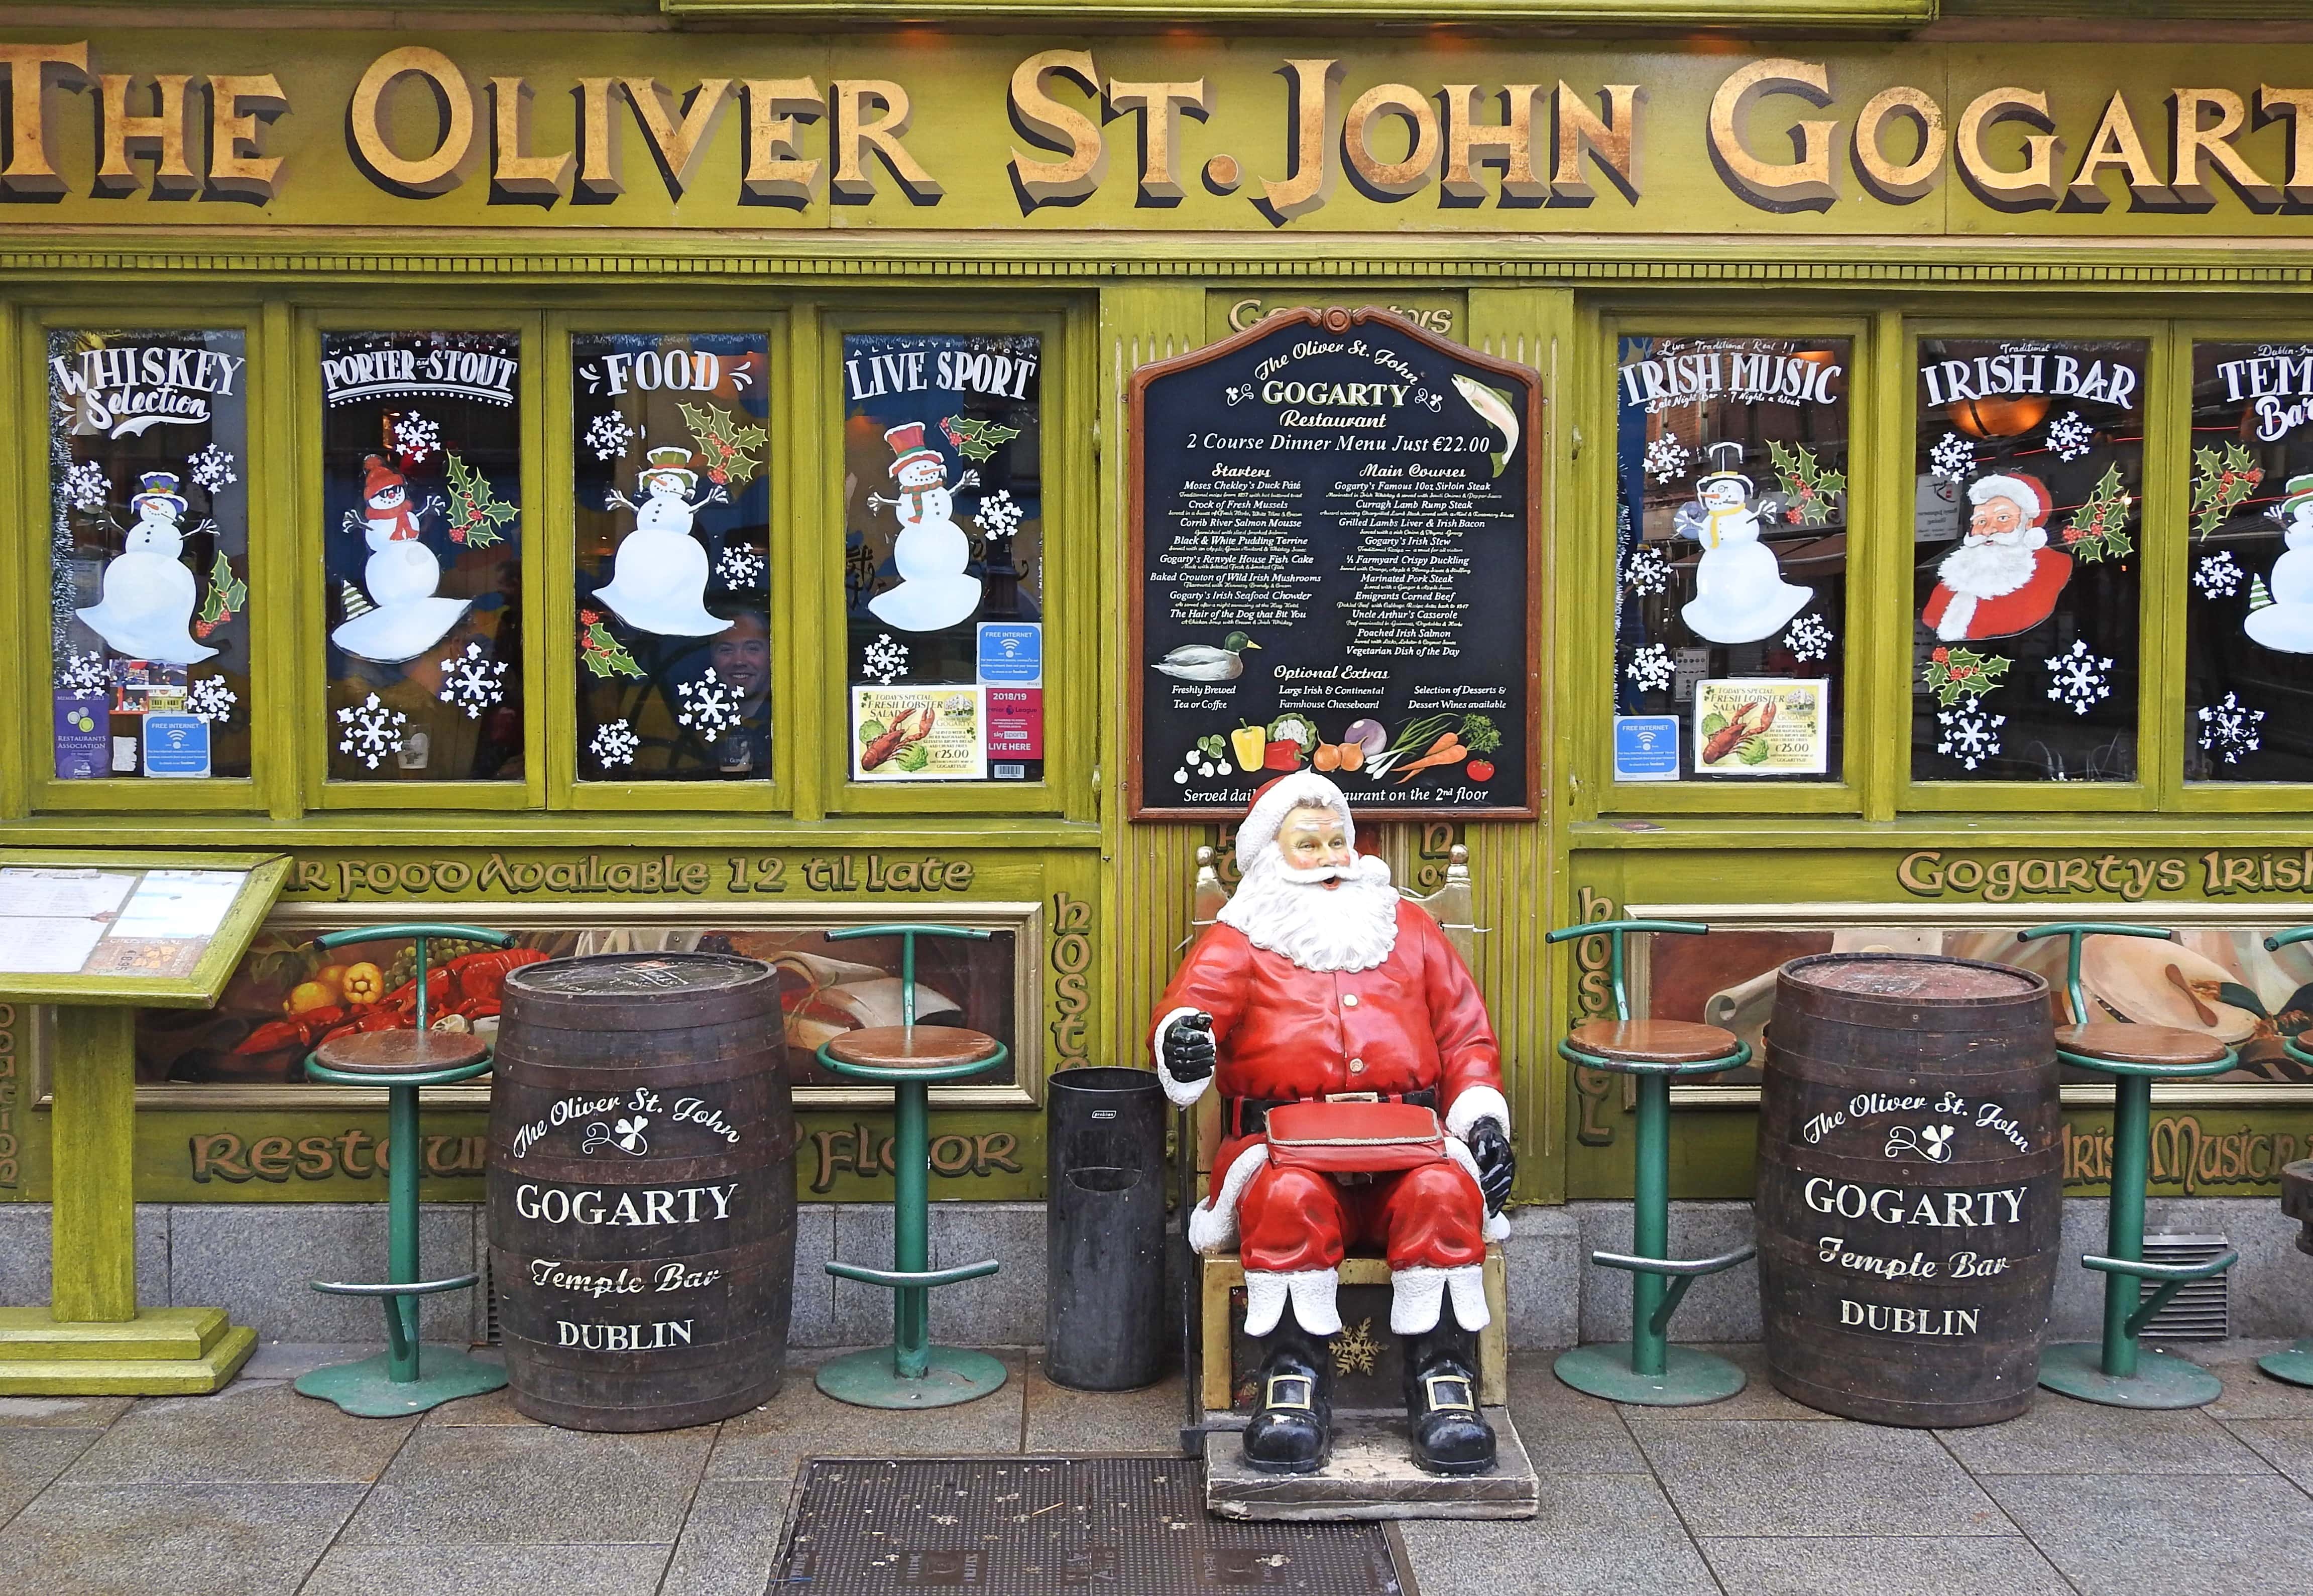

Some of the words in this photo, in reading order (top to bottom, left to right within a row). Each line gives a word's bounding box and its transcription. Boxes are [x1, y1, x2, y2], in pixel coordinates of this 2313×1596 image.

[0, 40, 293, 205] THE
[346, 46, 945, 211] OLIVER
[1007, 48, 1241, 216] ST.
[1249, 58, 1647, 223] JOHN
[329, 341, 391, 355] WINE
[415, 341, 506, 354] SPIRITS
[854, 342, 951, 356] ALLWAYS
[974, 345, 1037, 360] SHOWN
[1657, 340, 1685, 356] Live
[1695, 340, 1745, 351] Traditional
[1754, 339, 1775, 350] Real
[2000, 343, 2050, 353] Traditional
[49, 347, 246, 396] WHISKEY
[321, 350, 416, 392] PORTER
[426, 350, 517, 391] STOUT
[602, 349, 719, 396] FOOD
[1255, 353, 1290, 381] The
[1293, 342, 1344, 359] Oliver
[1348, 340, 1370, 357] St.
[1375, 349, 1419, 385] John
[846, 351, 930, 400] LIVE
[937, 351, 1036, 400] SPORT
[1618, 352, 1722, 407] IRISH
[1728, 352, 1841, 405] MUSIC
[1921, 355, 2045, 407] IRISH
[2050, 355, 2135, 410] BAR
[1262, 381, 1411, 407] GOGARTY
[1645, 397, 1672, 414] Late
[1673, 393, 1697, 408] Night
[1696, 392, 1717, 402] Bar
[1731, 392, 1738, 403] 7
[1739, 393, 1765, 406] Nights
[1777, 395, 1801, 407] Week
[85, 382, 210, 430] Selection
[1280, 410, 1386, 428] Restaurant
[1187, 434, 1197, 449] 2
[1203, 433, 1264, 449] Course
[1269, 434, 1332, 450] Dinner
[1335, 434, 1386, 451] Menu
[1392, 436, 1429, 452] Just
[1432, 436, 1490, 452] €22.00
[1212, 463, 1271, 477] Starters
[1359, 463, 1404, 477] Main
[1409, 463, 1466, 477] Courses
[1184, 481, 1211, 489] Moses
[1214, 481, 1255, 491] Chekley's
[1282, 481, 1301, 489] Pâté
[1335, 482, 1375, 492] Gogarty's
[1377, 482, 1412, 490] Famous
[1414, 482, 1433, 490] 10oz
[1436, 482, 1465, 490] Sirloin
[1467, 482, 1490, 490] Steak
[1180, 518, 1207, 527] Corrib
[1234, 518, 1266, 527] Salmon
[1268, 519, 1302, 527] Mousse
[1365, 537, 1406, 546] Gogarty's
[1408, 537, 1428, 545] Irish
[1430, 537, 1451, 545] Stew
[1170, 591, 1210, 600] Gogarty's
[1213, 591, 1233, 599] Irish
[1235, 591, 1269, 601] Seafood
[1272, 592, 1312, 600] Chowder
[1352, 610, 1376, 619] Uncle
[1377, 610, 1415, 619] Arthur's
[1417, 610, 1458, 619] Casserole
[1274, 665, 1338, 681] Optional
[1341, 665, 1390, 679] Extras
[1172, 685, 1203, 696] Freshly
[1204, 685, 1236, 694] Brewed
[1174, 700, 1189, 708] Tea
[1201, 700, 1227, 710] Coffee
[1184, 789, 1227, 802] Served
[1389, 792, 1406, 800] on
[1411, 789, 1430, 800] the
[1435, 788, 1453, 800] 2nd
[1454, 787, 1488, 803] floor
[728, 857, 786, 893] 12
[804, 855, 859, 892] til
[866, 854, 975, 893] late
[513, 1119, 547, 1158] The
[550, 1096, 621, 1126] Oliver
[628, 1087, 663, 1113] St.
[672, 1097, 741, 1143] John
[1804, 1111, 1846, 1144] The
[1849, 1092, 1928, 1117] Oliver
[1934, 1091, 1968, 1116] St.
[1976, 1103, 2029, 1153] John
[516, 1183, 738, 1225] GOGARTY
[1805, 1177, 2027, 1226] GOGARTY
[1819, 1237, 1937, 1280] Temple
[1948, 1252, 2010, 1278] Bar
[531, 1259, 644, 1298] Temple
[654, 1263, 722, 1292] Bar
[1840, 1300, 1980, 1335] DUBLIN
[557, 1319, 695, 1352] DUBLIN
